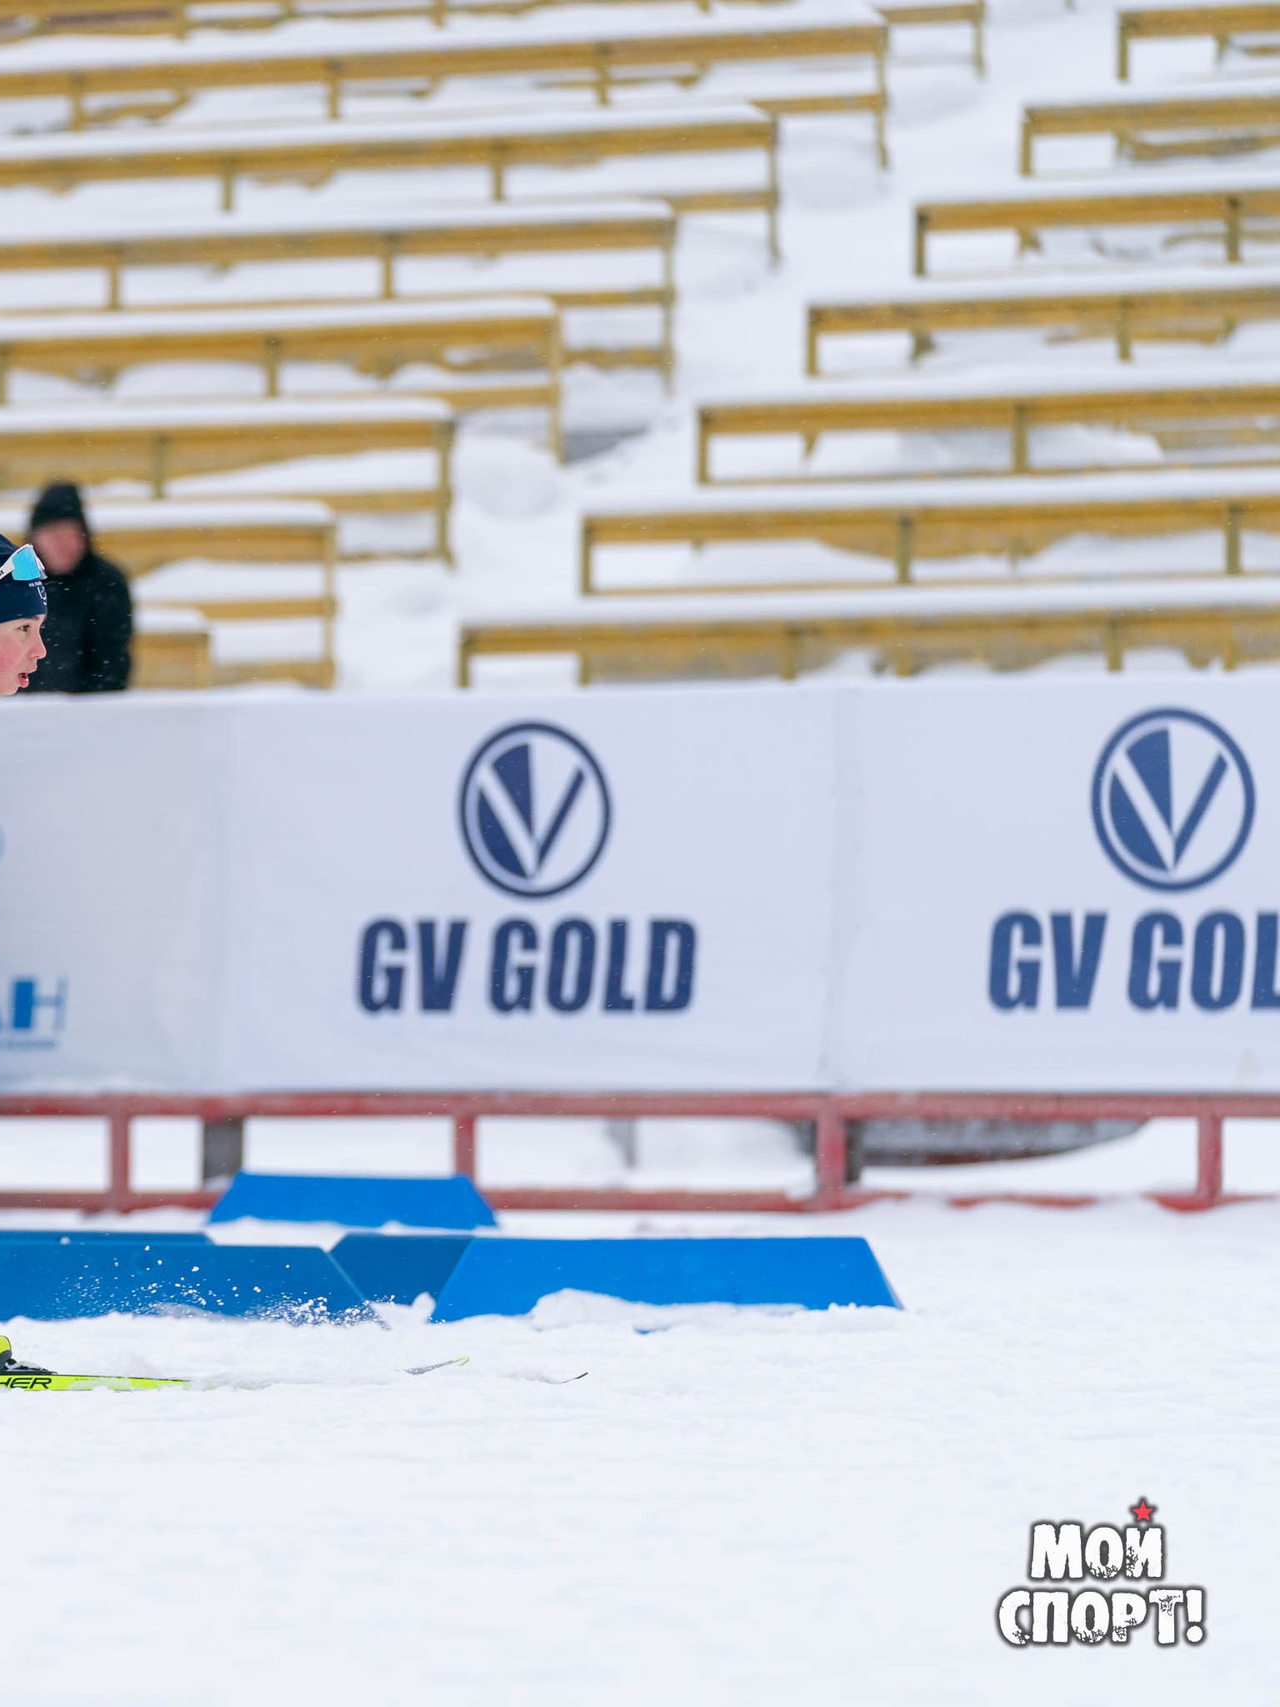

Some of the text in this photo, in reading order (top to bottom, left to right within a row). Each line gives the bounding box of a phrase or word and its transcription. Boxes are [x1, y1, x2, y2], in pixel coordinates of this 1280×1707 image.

[358, 917, 697, 1013] GV GOLD
[987, 908, 1280, 1011] GV GOL
